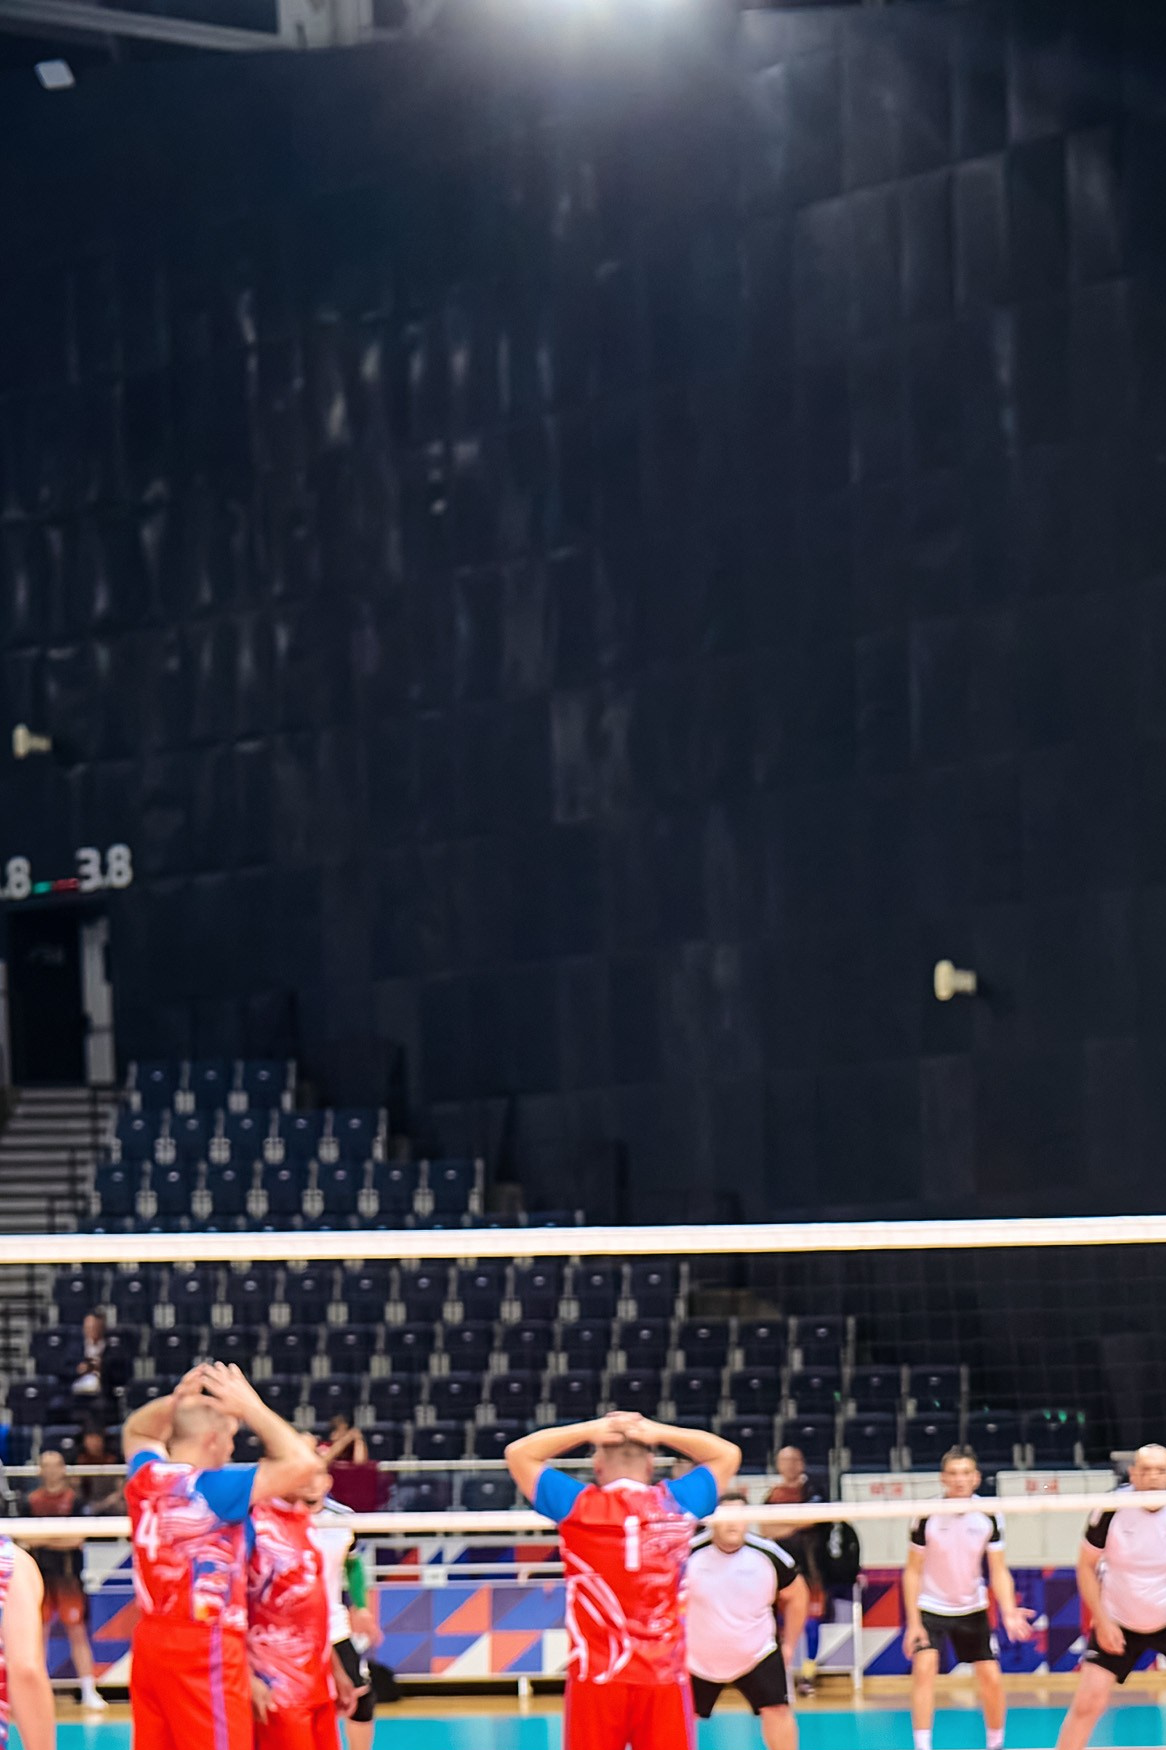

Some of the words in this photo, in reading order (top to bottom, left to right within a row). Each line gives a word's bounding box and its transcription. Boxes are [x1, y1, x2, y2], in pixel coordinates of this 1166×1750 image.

[76, 844, 133, 891] 3.8
[136, 1499, 160, 1562] 4
[624, 1515, 641, 1571] 1
